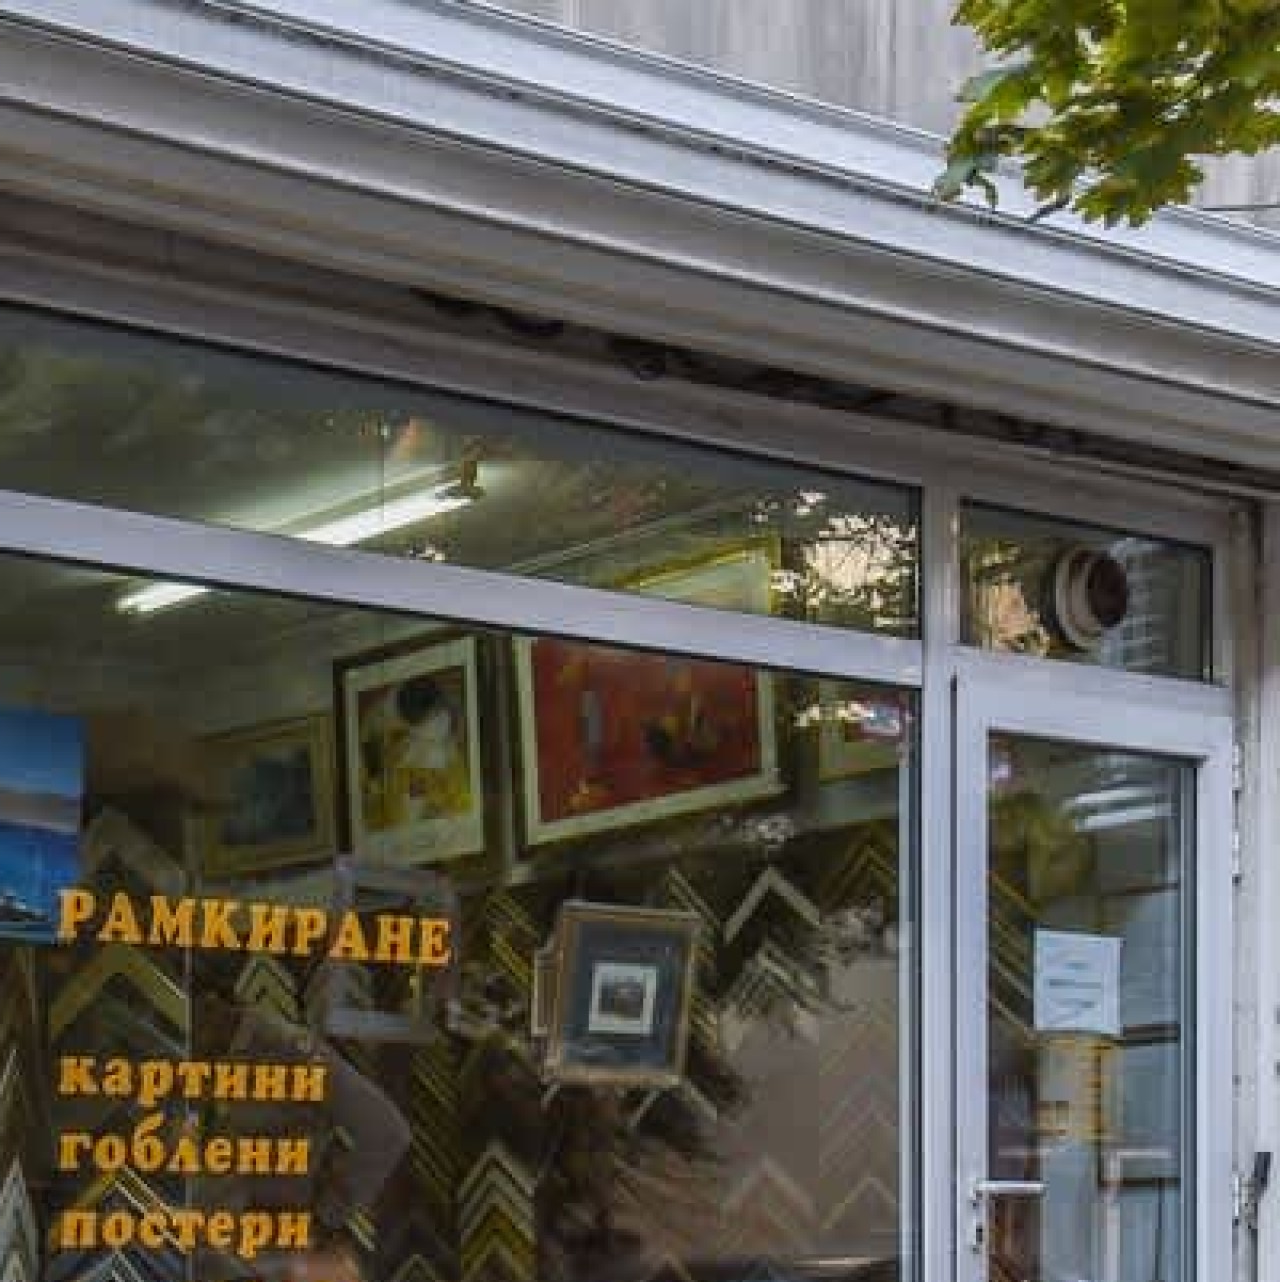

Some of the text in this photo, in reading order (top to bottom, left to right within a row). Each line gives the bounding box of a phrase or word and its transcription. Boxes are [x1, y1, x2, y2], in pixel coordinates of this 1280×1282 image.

[56, 888, 452, 965] РАМКИРАНЕ
[57, 1055, 327, 1107] картини
[57, 1112, 310, 1174] гоблени
[57, 1208, 311, 1258] постери
